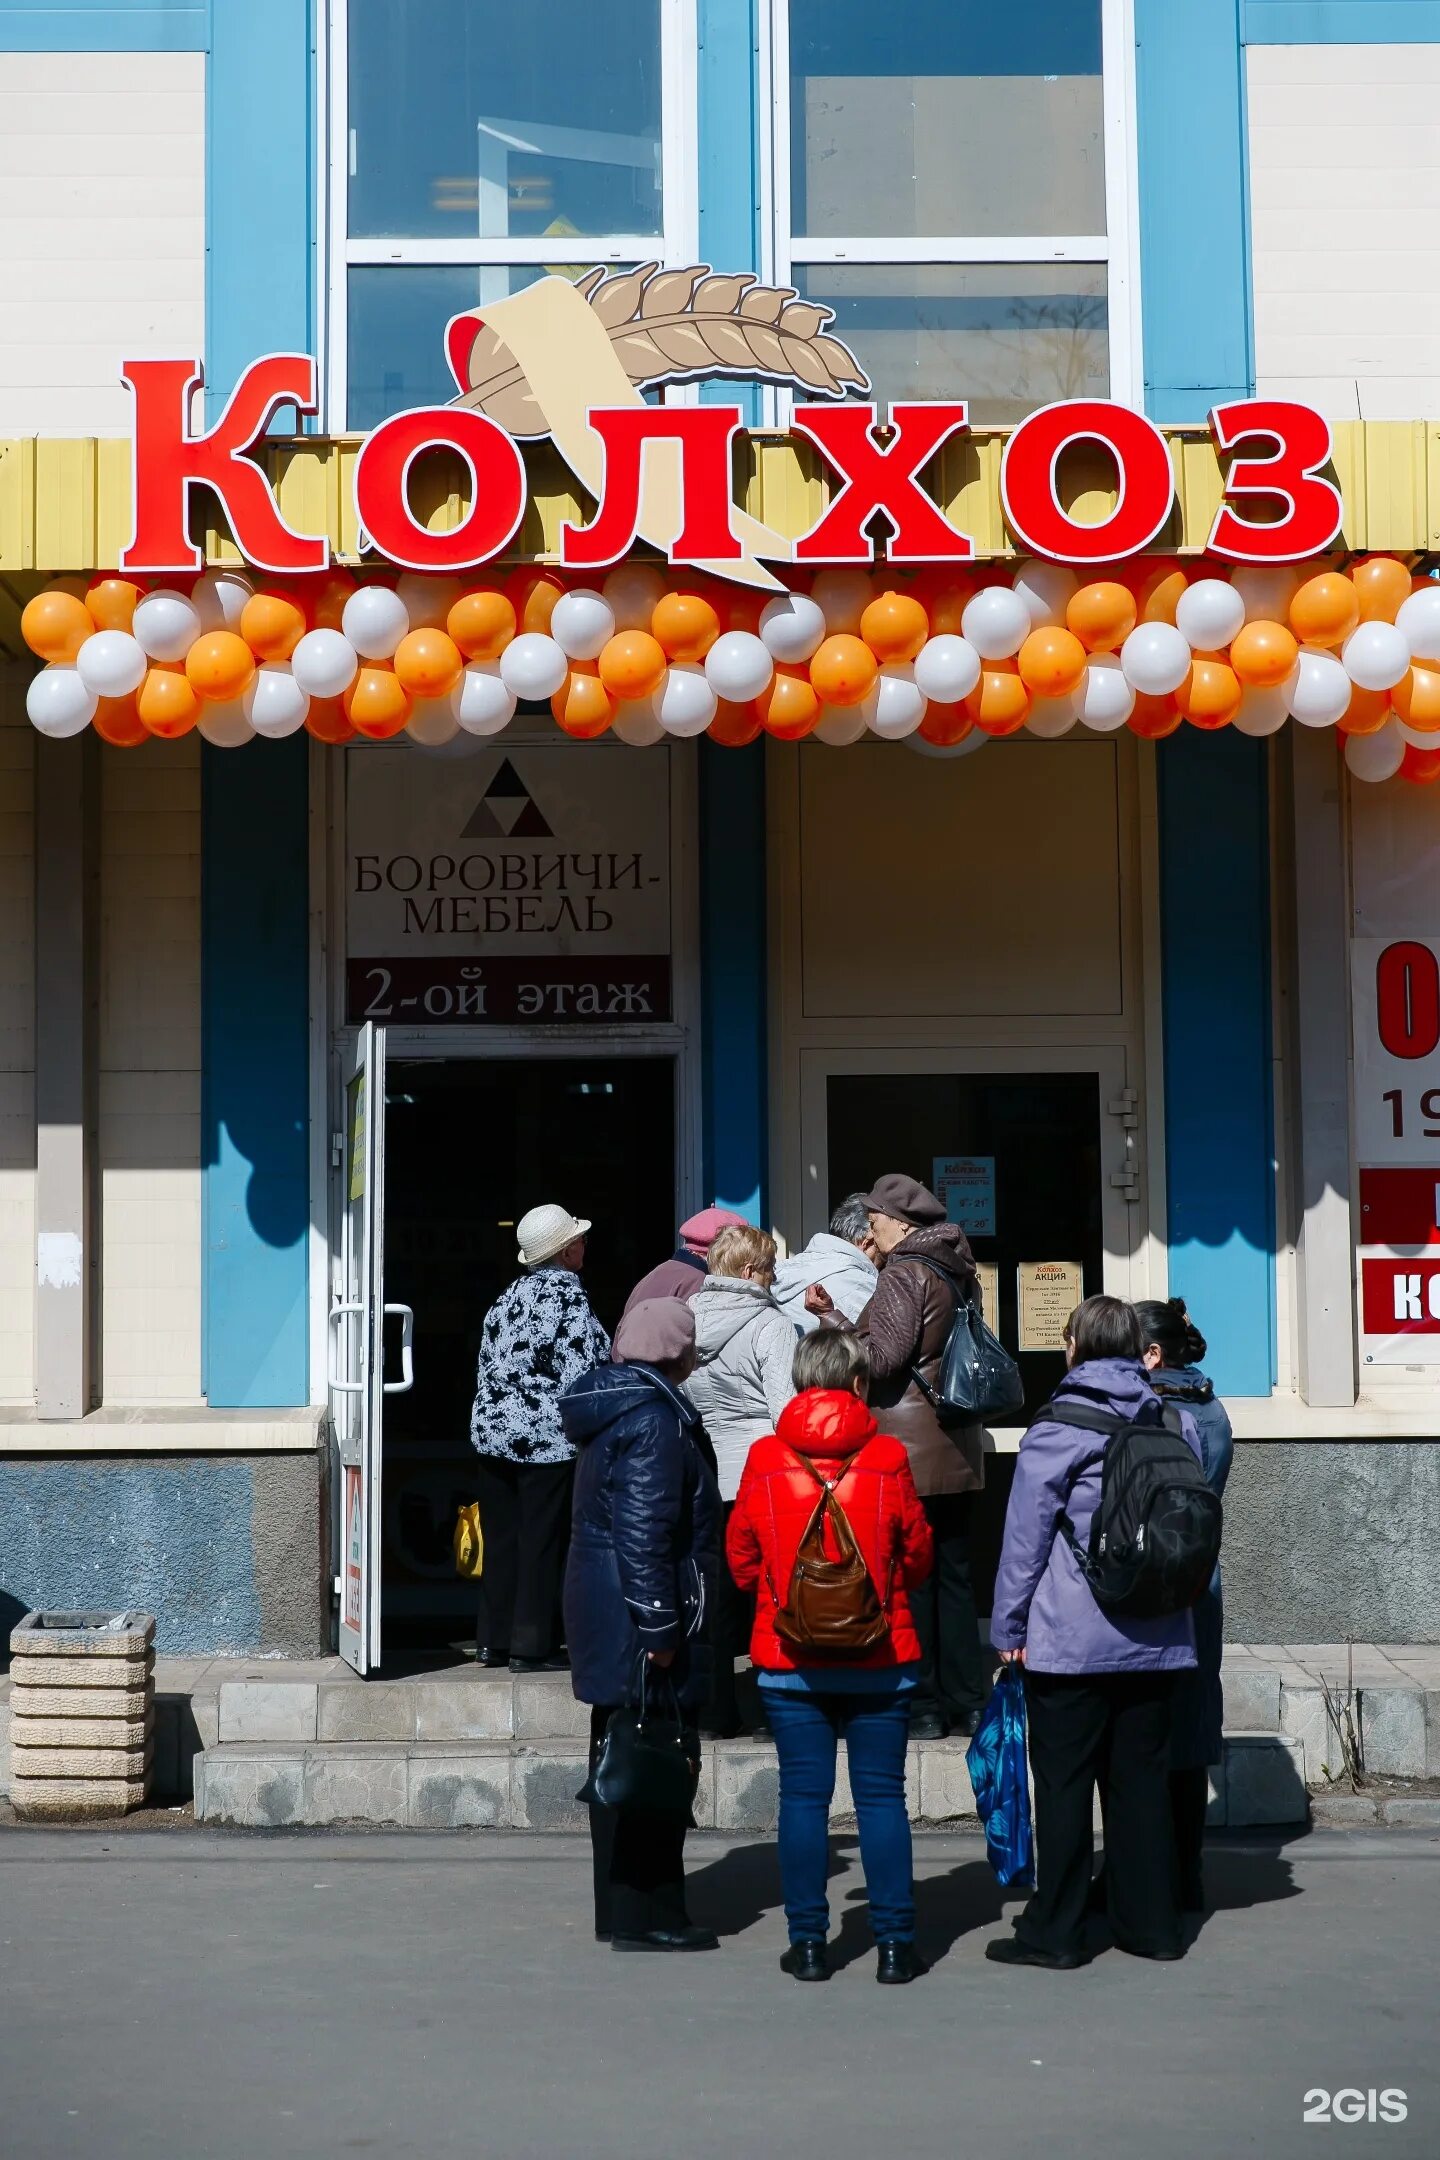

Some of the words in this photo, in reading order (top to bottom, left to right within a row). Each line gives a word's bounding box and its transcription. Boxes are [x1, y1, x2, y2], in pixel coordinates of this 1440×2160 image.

[119, 352, 1345, 574] Колхоз
[353, 853, 661, 893] БОРОВИЧИ-
[402, 895, 614, 934] МЕБЕЛЬ
[363, 966, 488, 1017] 2-ой
[517, 982, 654, 1015] этаж
[1035, 1272, 1067, 1282] АКЦИЯ
